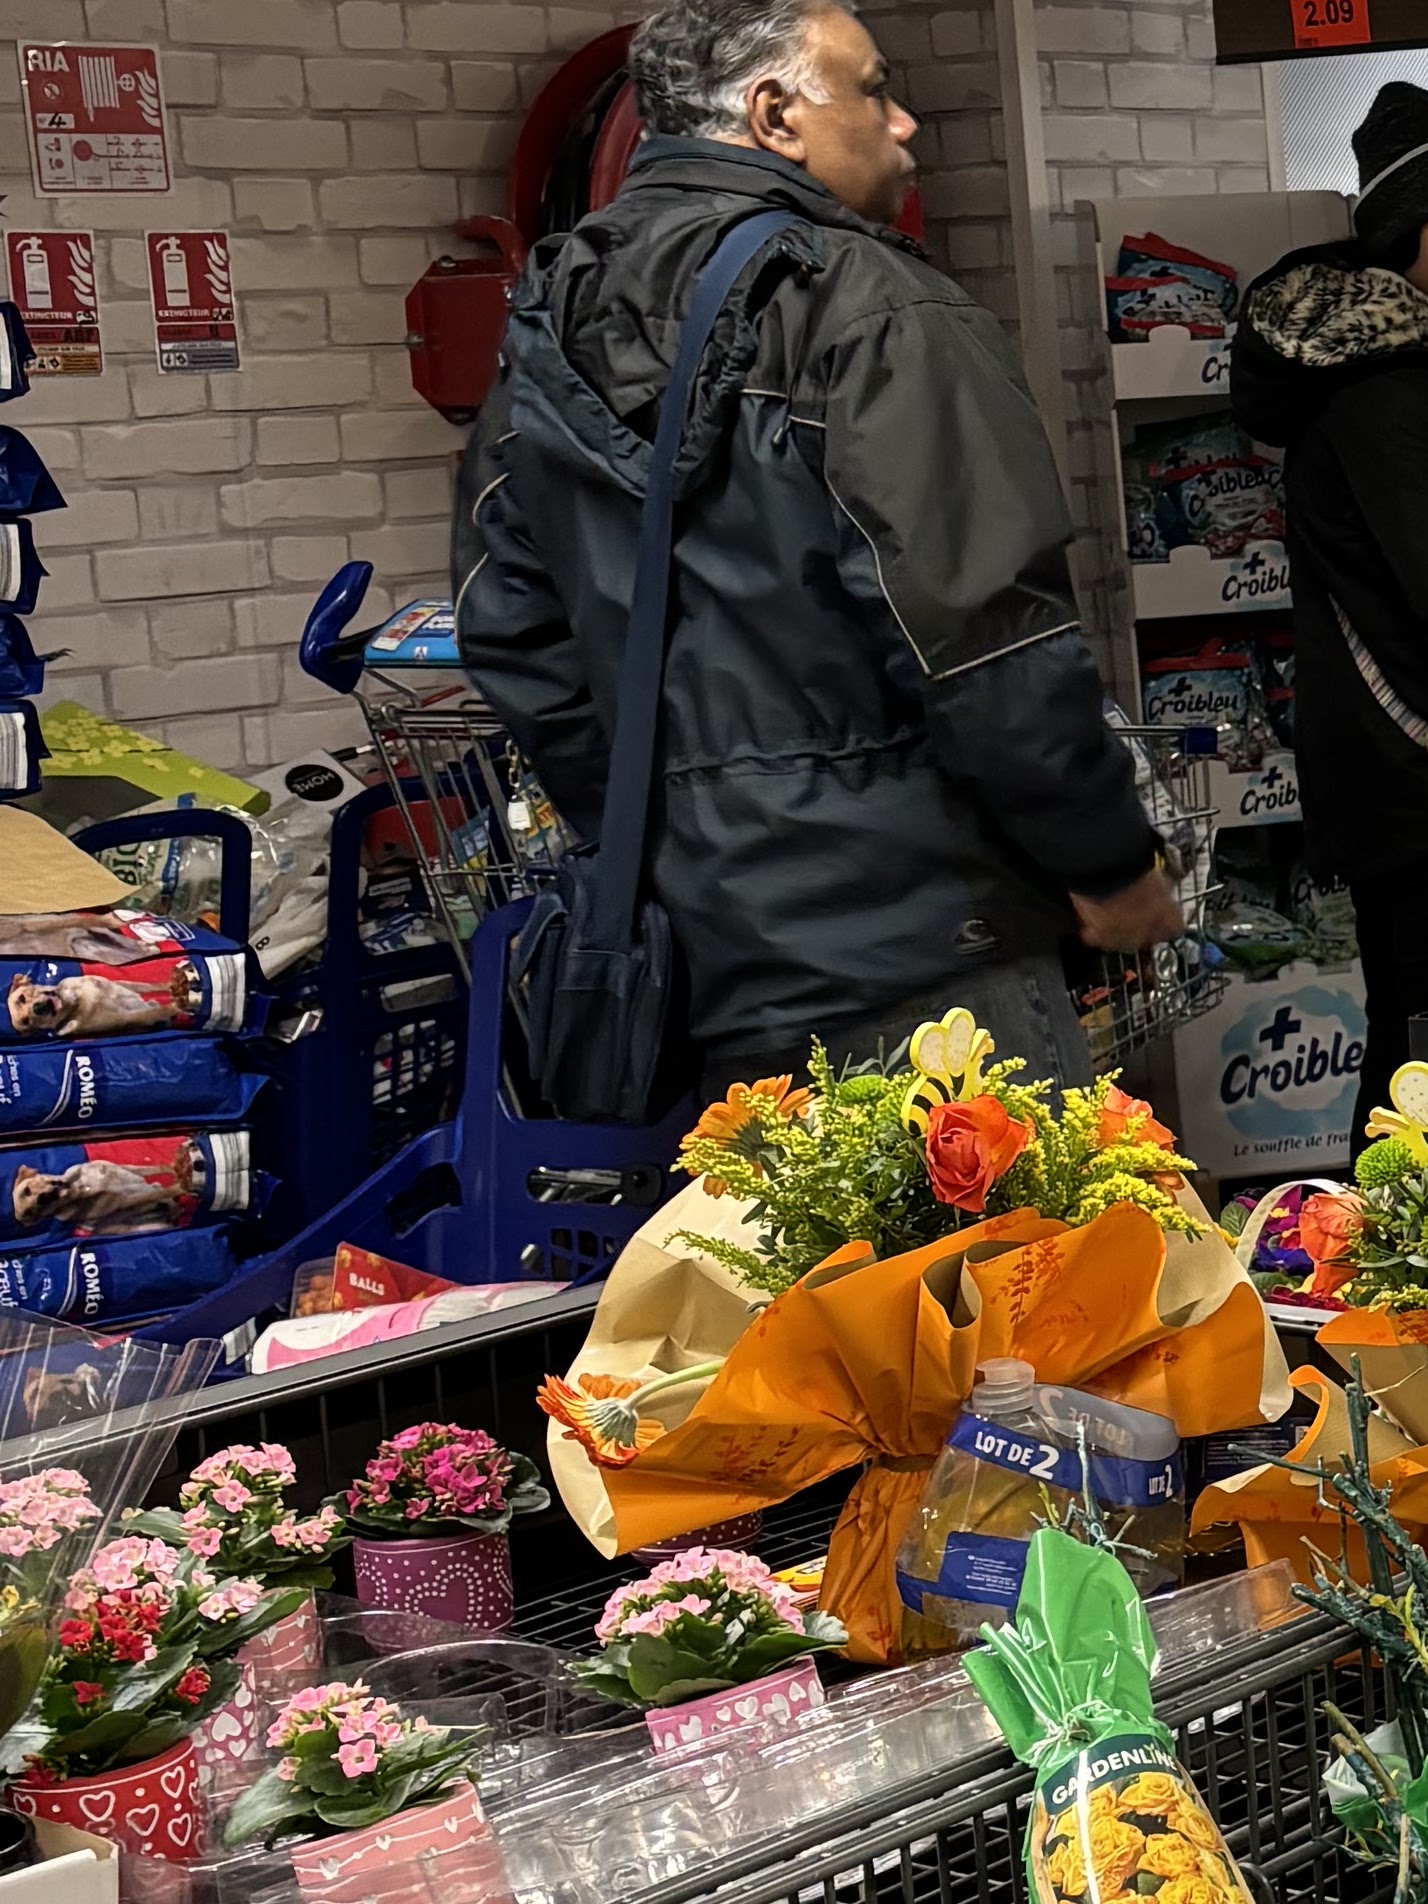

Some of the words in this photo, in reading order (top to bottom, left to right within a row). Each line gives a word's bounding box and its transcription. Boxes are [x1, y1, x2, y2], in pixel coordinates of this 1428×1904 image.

[27, 49, 70, 73] RIA
[1148, 693, 1239, 721] Croibleu
[1240, 784, 1302, 817] Croib
[75, 1055, 97, 1119] ROMÉO
[1233, 1142, 1249, 1158] Le
[80, 1252, 103, 1315] ROMÉO
[349, 1272, 385, 1296] BALLS
[974, 1431, 1008, 1458] LOT
[1007, 1444, 1035, 1467] DE
[1029, 1444, 1060, 1480] 2
[1164, 1464, 1174, 1498] 2
